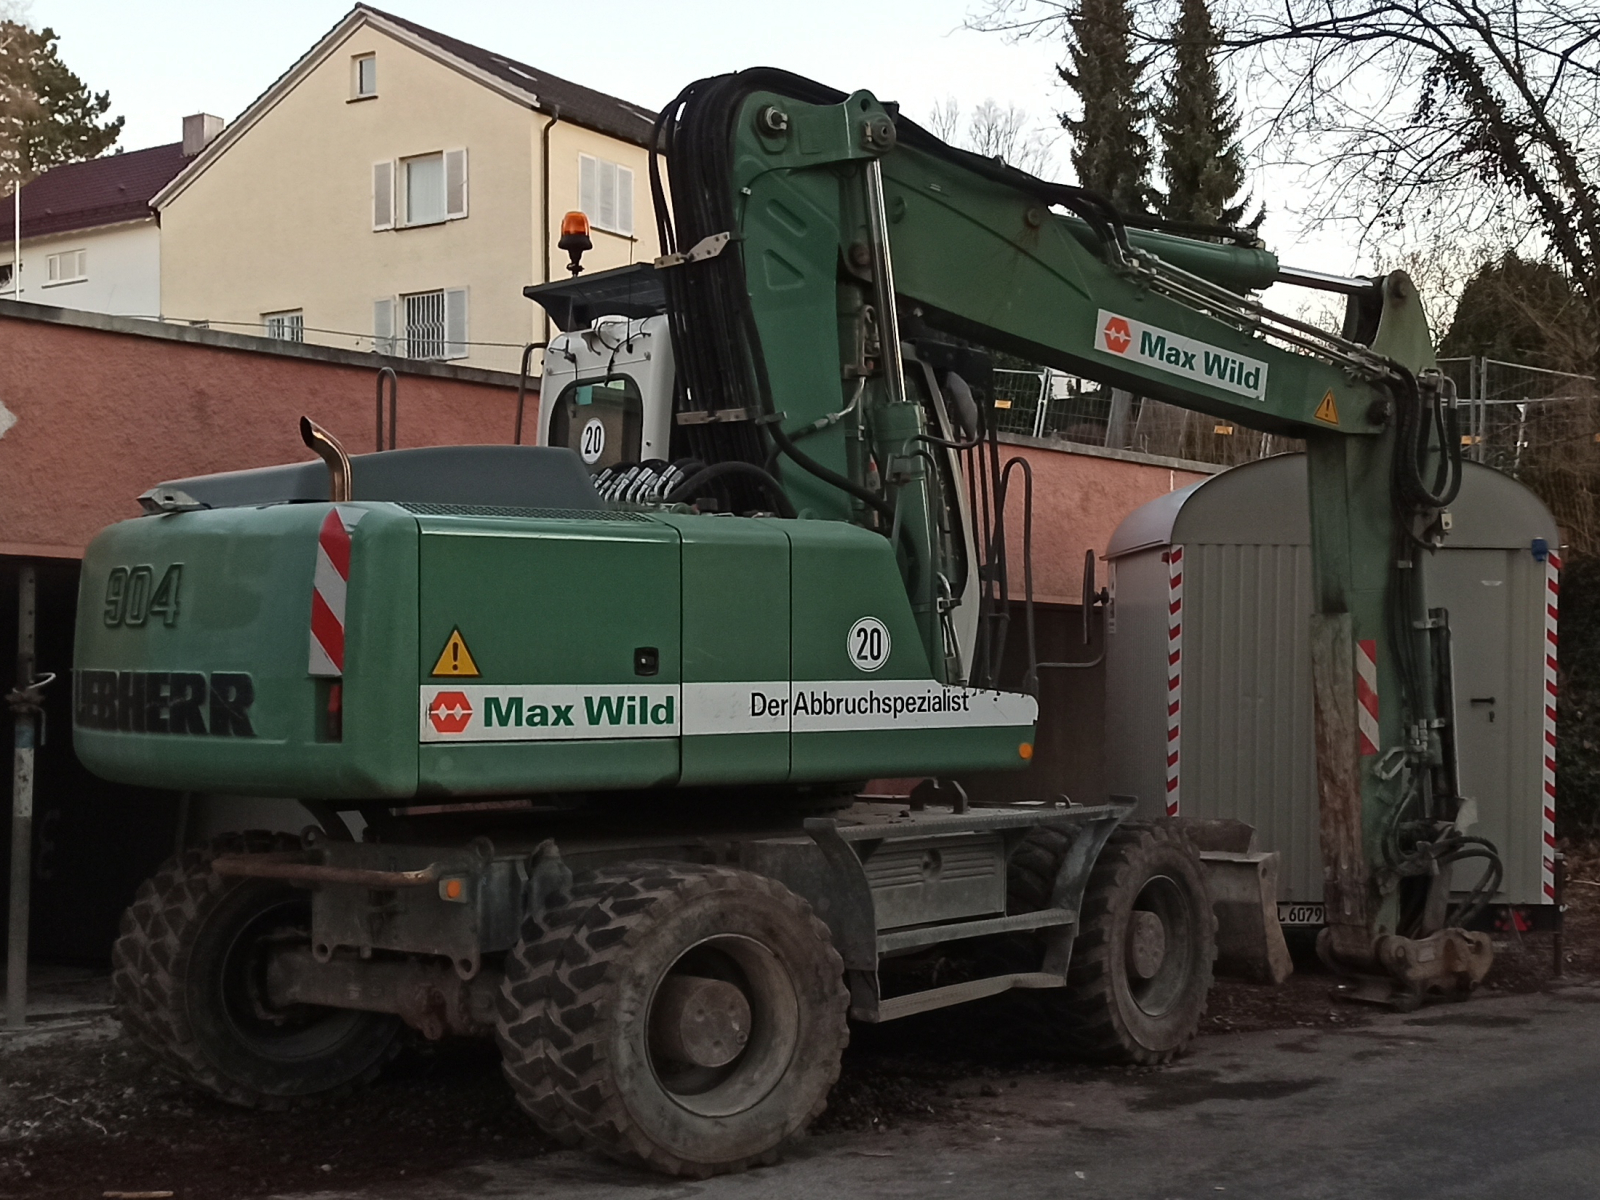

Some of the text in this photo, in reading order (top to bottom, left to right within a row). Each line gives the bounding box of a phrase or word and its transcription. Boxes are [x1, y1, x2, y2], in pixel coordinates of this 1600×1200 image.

[1140, 331, 1261, 391] Max Wild
[584, 425, 602, 455] 20
[104, 562, 184, 628] 904
[856, 627, 882, 661] 20
[483, 695, 675, 727] Max Wild
[751, 689, 970, 718] Der Abbruchspezialist
[1288, 906, 1323, 923] 6079
